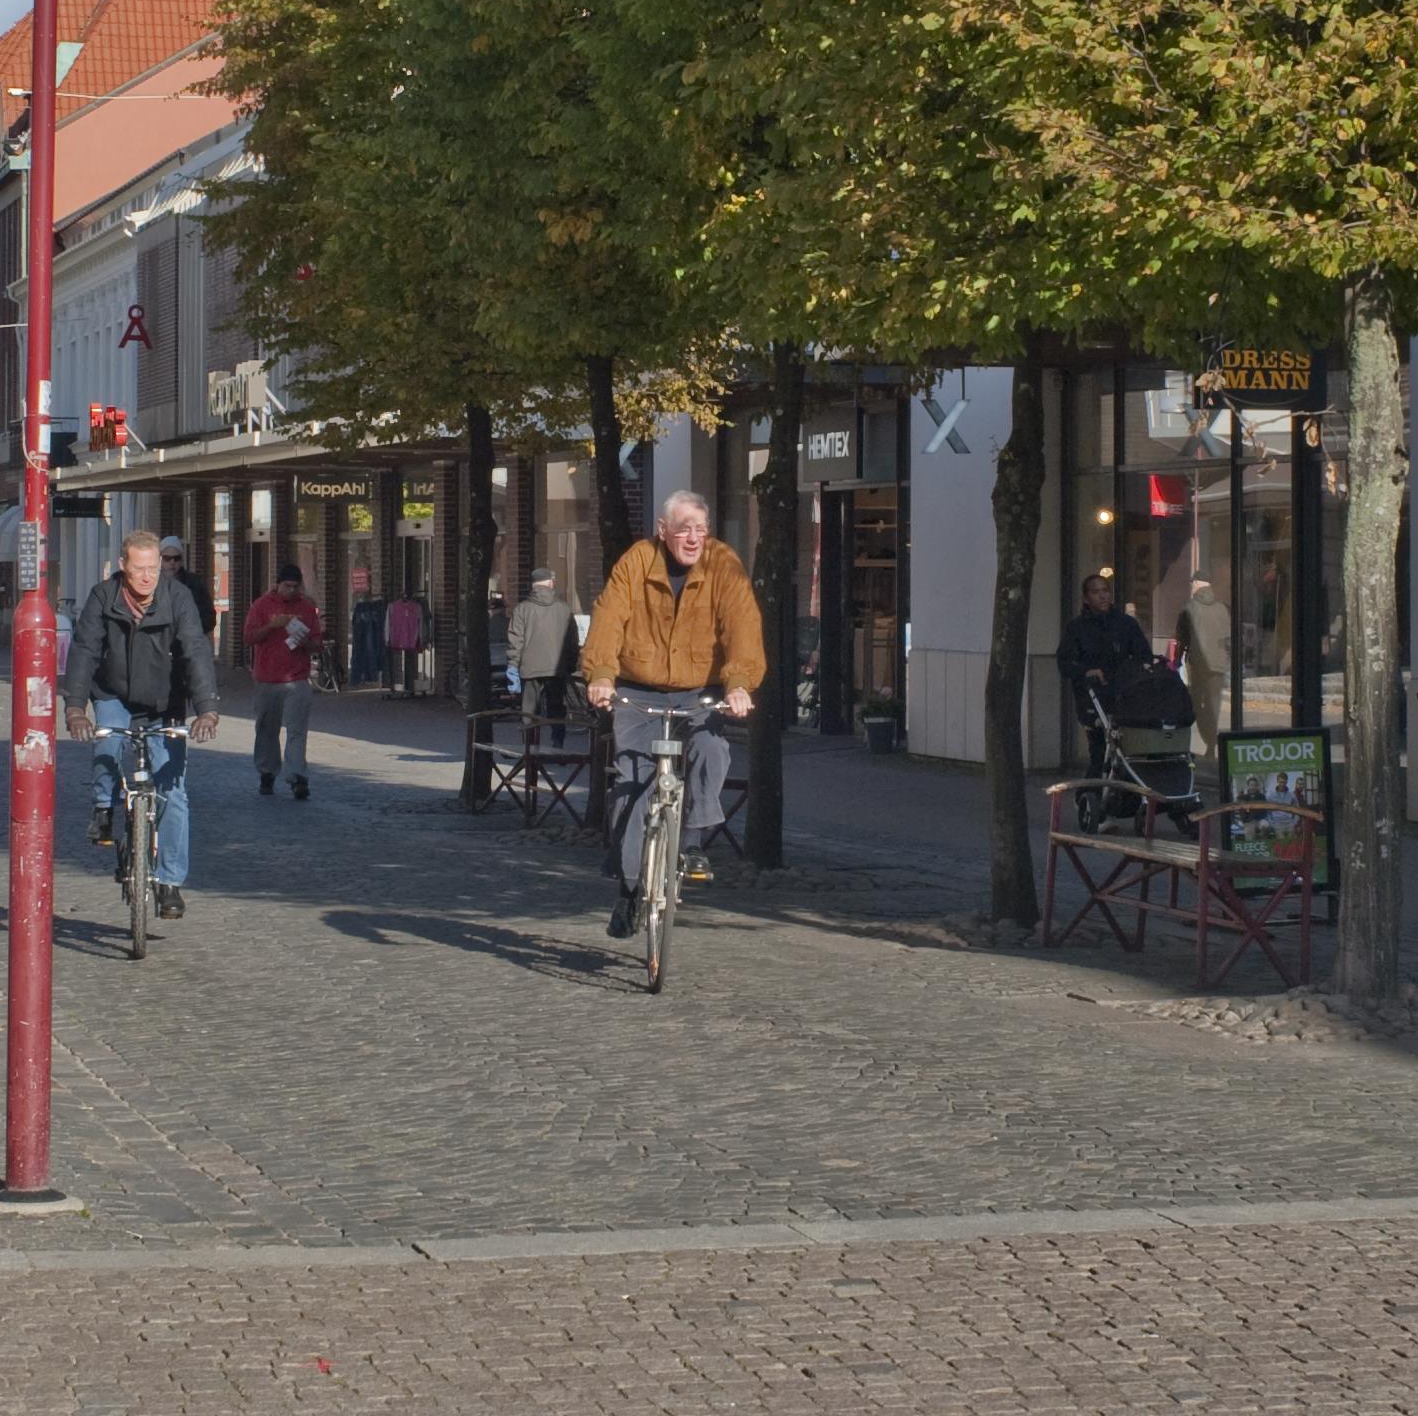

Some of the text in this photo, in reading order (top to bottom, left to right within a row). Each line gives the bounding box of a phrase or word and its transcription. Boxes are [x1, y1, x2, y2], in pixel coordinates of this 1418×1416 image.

[1223, 350, 1311, 369] DRESS
[1222, 371, 1311, 390] MANN
[808, 431, 850, 460] HEMTEX
[301, 482, 366, 498] KappAhl
[1233, 739, 1315, 763] TRÖJOR
